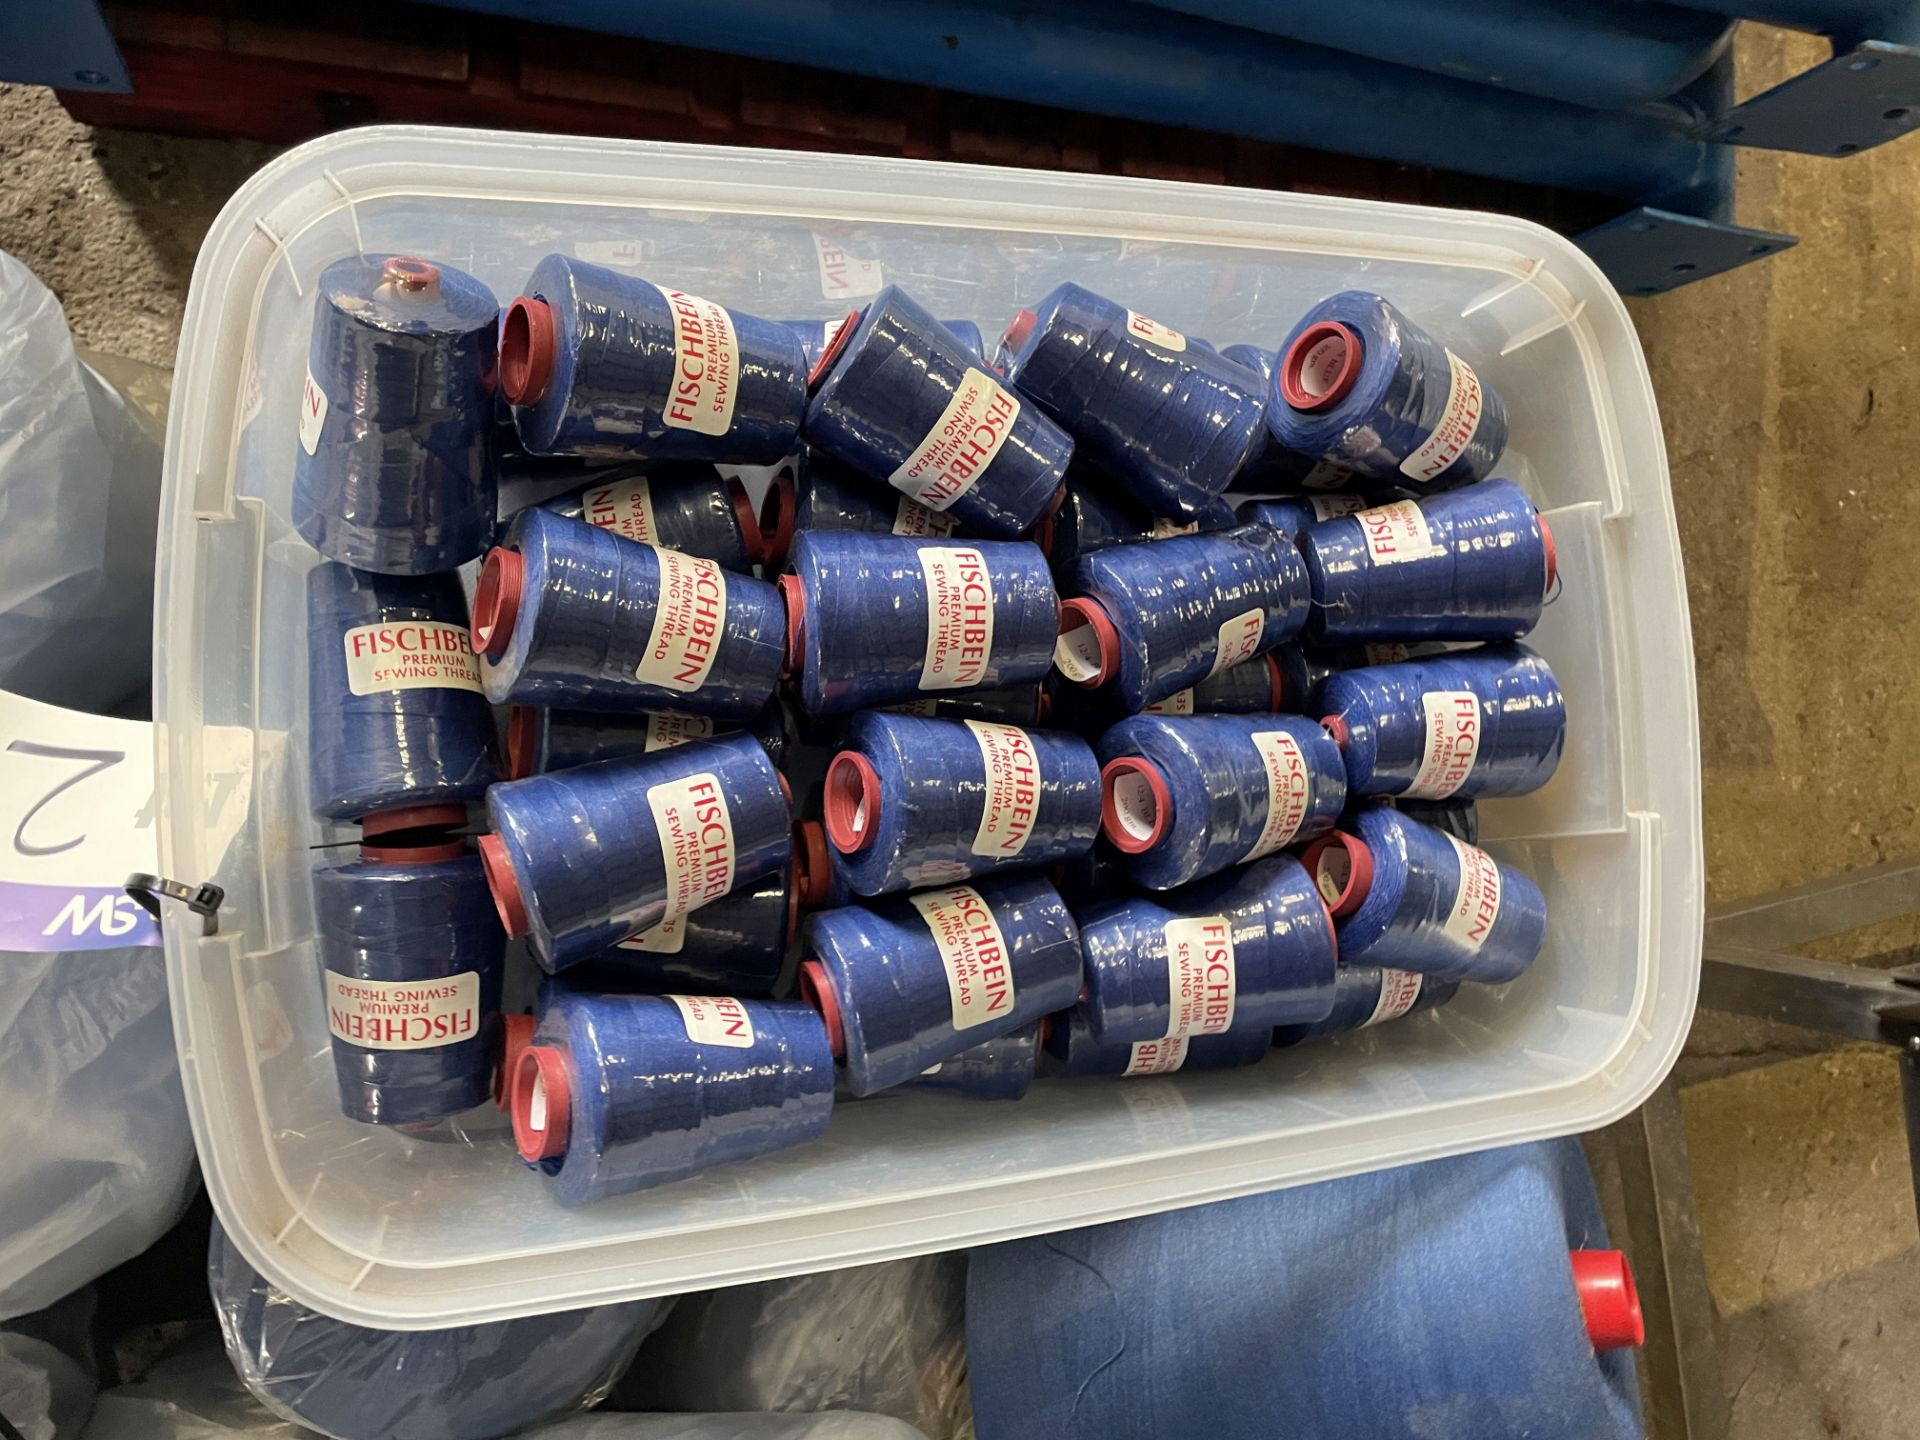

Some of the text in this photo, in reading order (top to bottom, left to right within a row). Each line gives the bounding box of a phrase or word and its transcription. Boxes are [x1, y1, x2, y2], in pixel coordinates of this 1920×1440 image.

[704, 318, 718, 382] PREMIUM
[714, 353, 730, 413] SEWING
[944, 387, 978, 436] SEWING
[932, 415, 977, 470] PREMIUM
[1421, 364, 1480, 476] FISCHBEIN
[1421, 416, 1453, 456] THREAD
[1443, 390, 1468, 443] PREMIUM
[908, 439, 945, 478] THREAD
[919, 392, 1013, 505] FISCHBEIN
[655, 555, 680, 660] SEWING THREAD
[673, 559, 719, 684] FISCHBEIN
[675, 575, 693, 636] PREMIUM
[933, 564, 949, 673] SEWING THREAD
[949, 586, 960, 650] PREMIUM
[953, 553, 986, 683] FISCHBEIN
[352, 628, 477, 657] FISCHBE
[402, 654, 465, 666] PREMIUM
[374, 666, 482, 685] SEWING THREAD
[1432, 712, 1444, 764] SEWING
[6, 739, 126, 857] 2
[981, 728, 1004, 833] SEWING THREAD
[1000, 748, 1013, 809] PREMIUM
[1000, 725, 1034, 850] FISCHBEIN
[1267, 751, 1282, 804] SEWING
[1276, 775, 1290, 832] PREMIUM
[665, 807, 688, 868] SEWING
[686, 831, 702, 893] PREMIUM
[688, 782, 728, 900] FISCHBEI
[1460, 871, 1474, 917] THREAD
[1467, 848, 1496, 942] CHBEIN
[927, 901, 971, 1006] SEWING THREAD
[946, 887, 1008, 1012] FISCHBEIN
[950, 915, 979, 977] PREMIUM
[1178, 942, 1191, 998] SEWING
[332, 1006, 472, 1042] FISCHBEIN
[338, 984, 458, 1003] SEWING THREAD
[359, 1002, 429, 1015] PREMIUM
[1192, 968, 1204, 1022] PREMIUM
